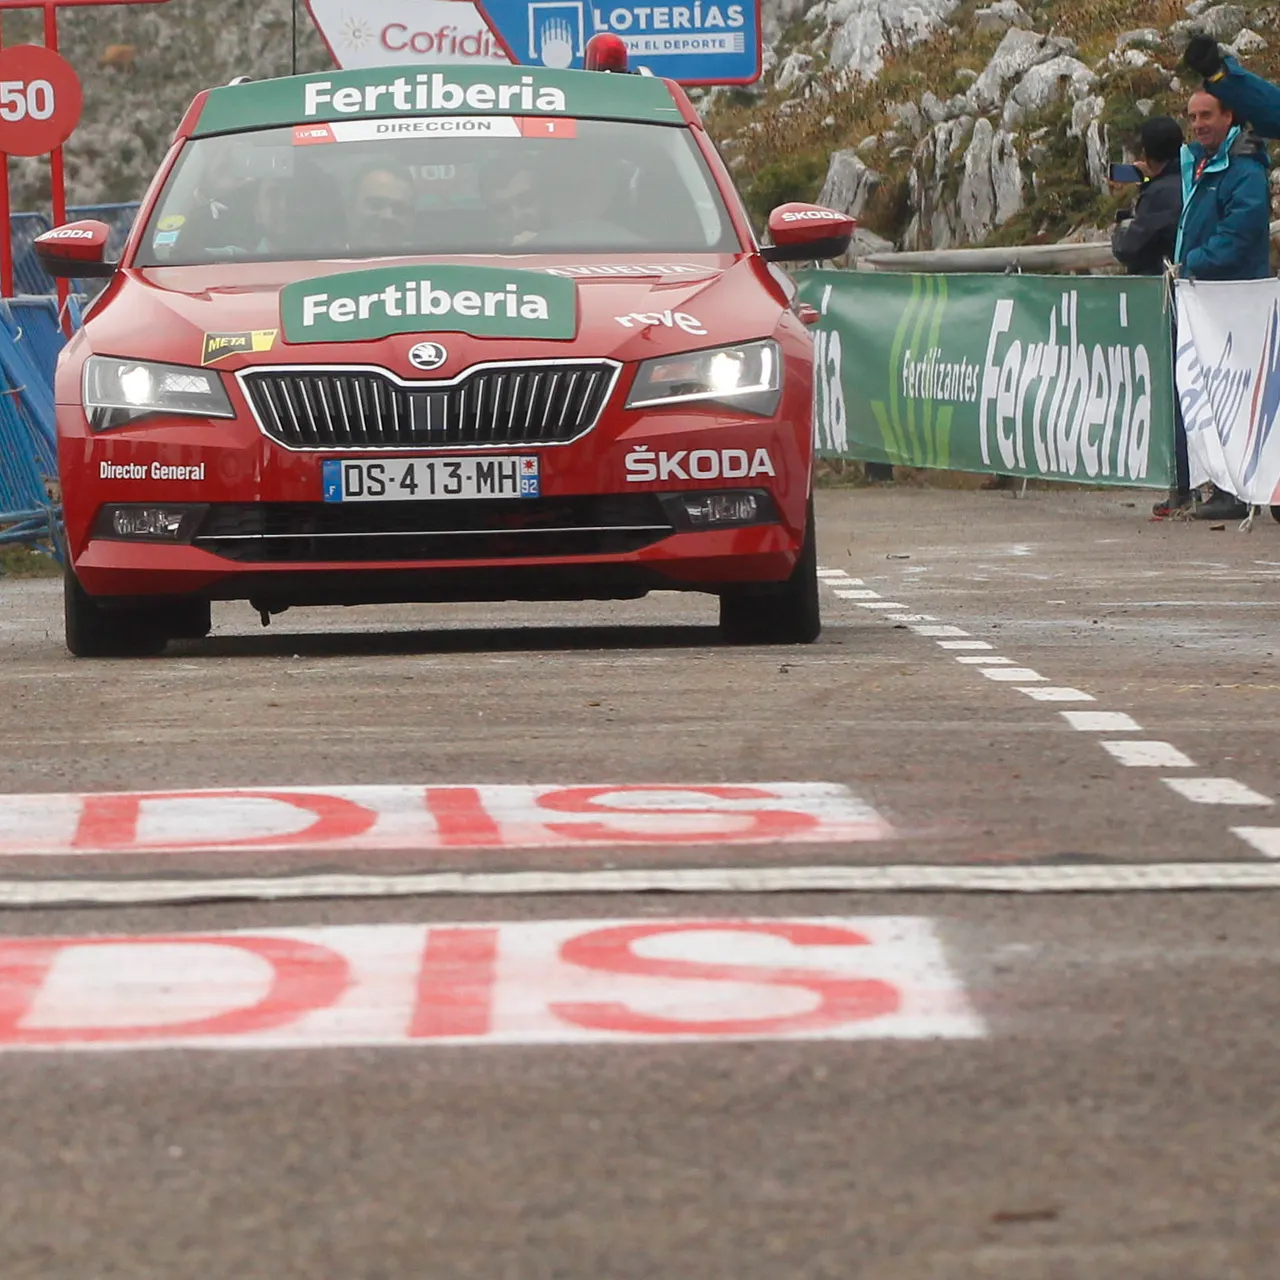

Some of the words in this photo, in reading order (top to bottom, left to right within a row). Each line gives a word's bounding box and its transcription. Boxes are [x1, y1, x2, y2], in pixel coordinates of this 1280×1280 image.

[594, 1, 744, 31] LOTERÍAS
[645, 40, 660, 50] EL
[664, 38, 726, 50] DEPORTE
[0, 79, 55, 122] 50
[304, 73, 566, 116] Fertiberia
[376, 120, 492, 134] DIRECCIÓN
[544, 122, 556, 133] 1
[303, 280, 549, 327] Fertiberia
[208, 337, 247, 352] META
[902, 347, 980, 403] Fertilizantes
[979, 290, 1151, 480] Fertiberia
[100, 461, 148, 480] Director
[151, 462, 205, 480] General
[344, 461, 519, 497] DS-413-MH
[625, 445, 776, 482] ŠKODA
[520, 479, 538, 494] 92
